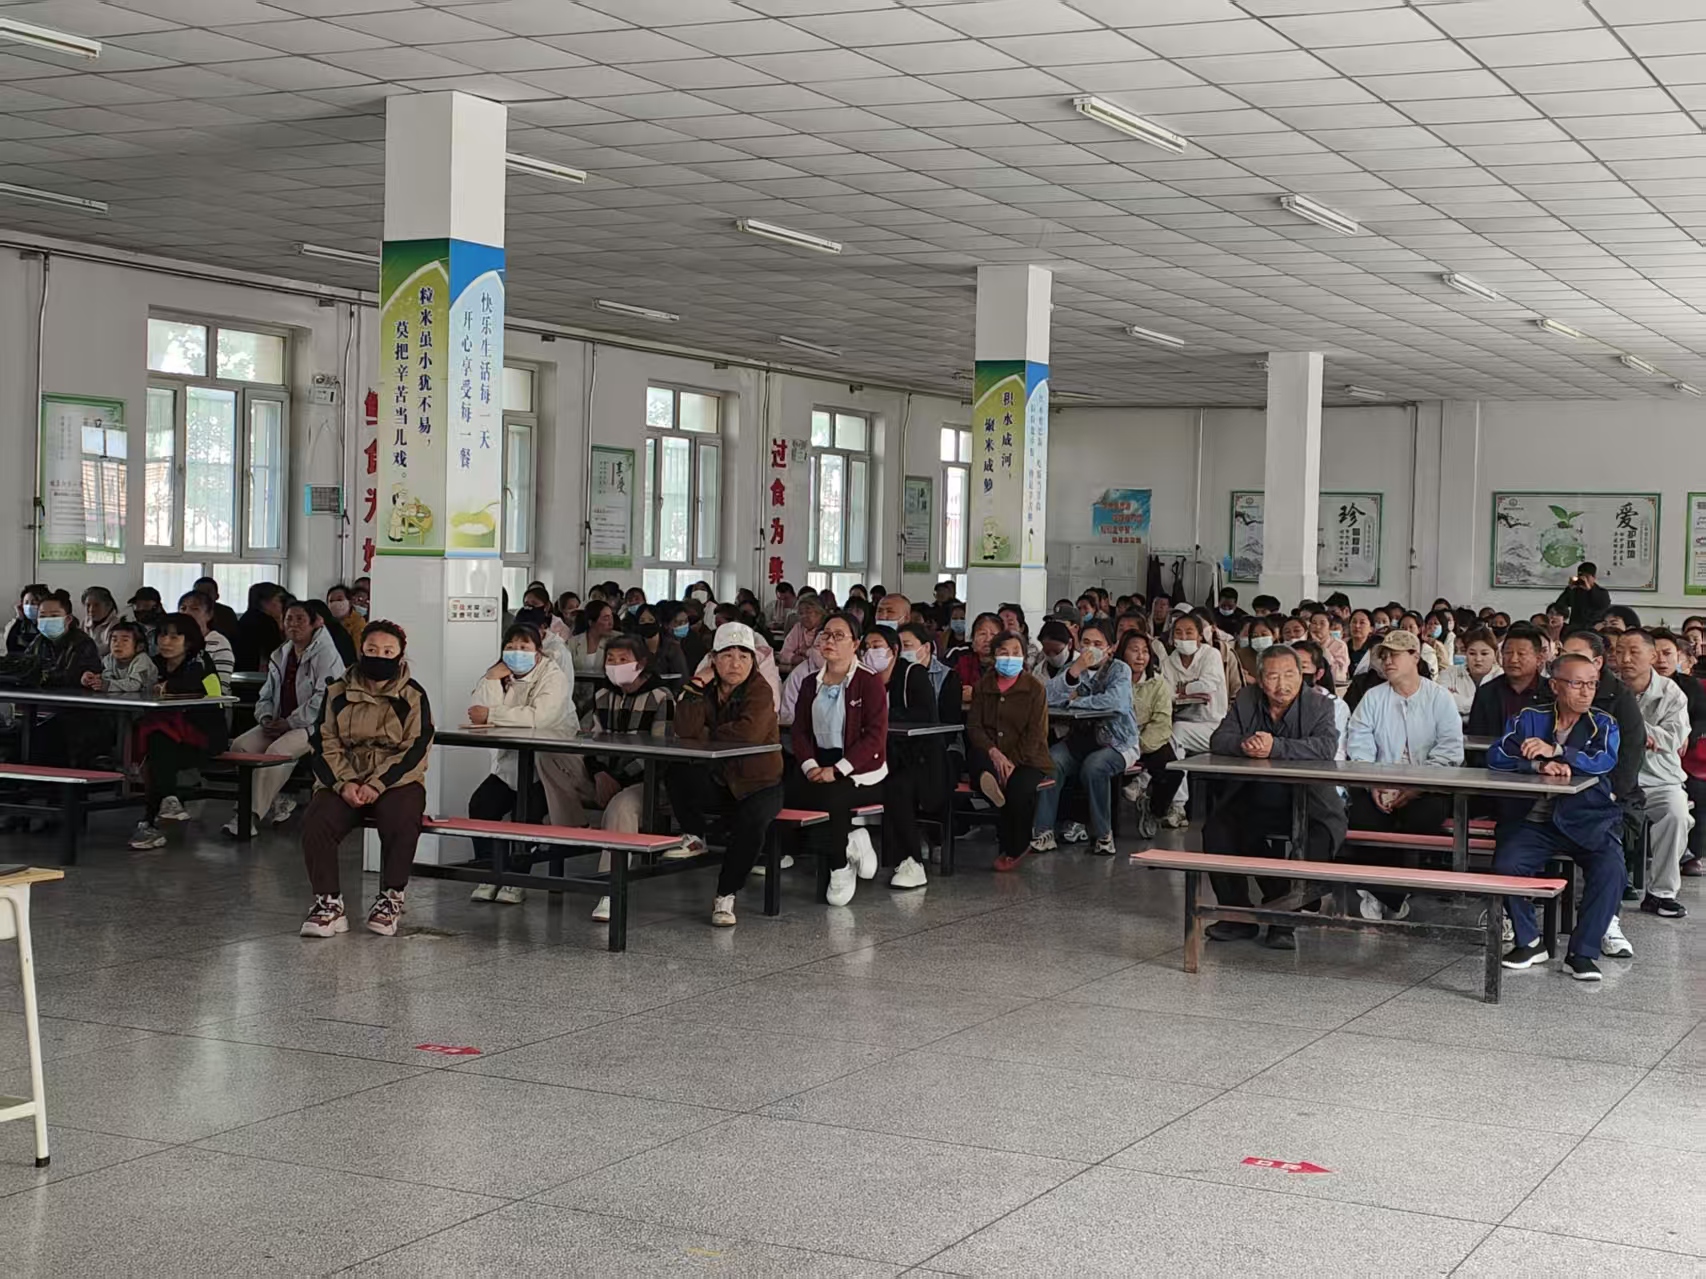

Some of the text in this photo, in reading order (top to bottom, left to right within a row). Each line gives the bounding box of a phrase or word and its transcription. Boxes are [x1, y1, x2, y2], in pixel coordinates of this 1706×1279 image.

[460, 311, 473, 469] 开心享受每一餐
[479, 292, 493, 450] 快乐生活每一天
